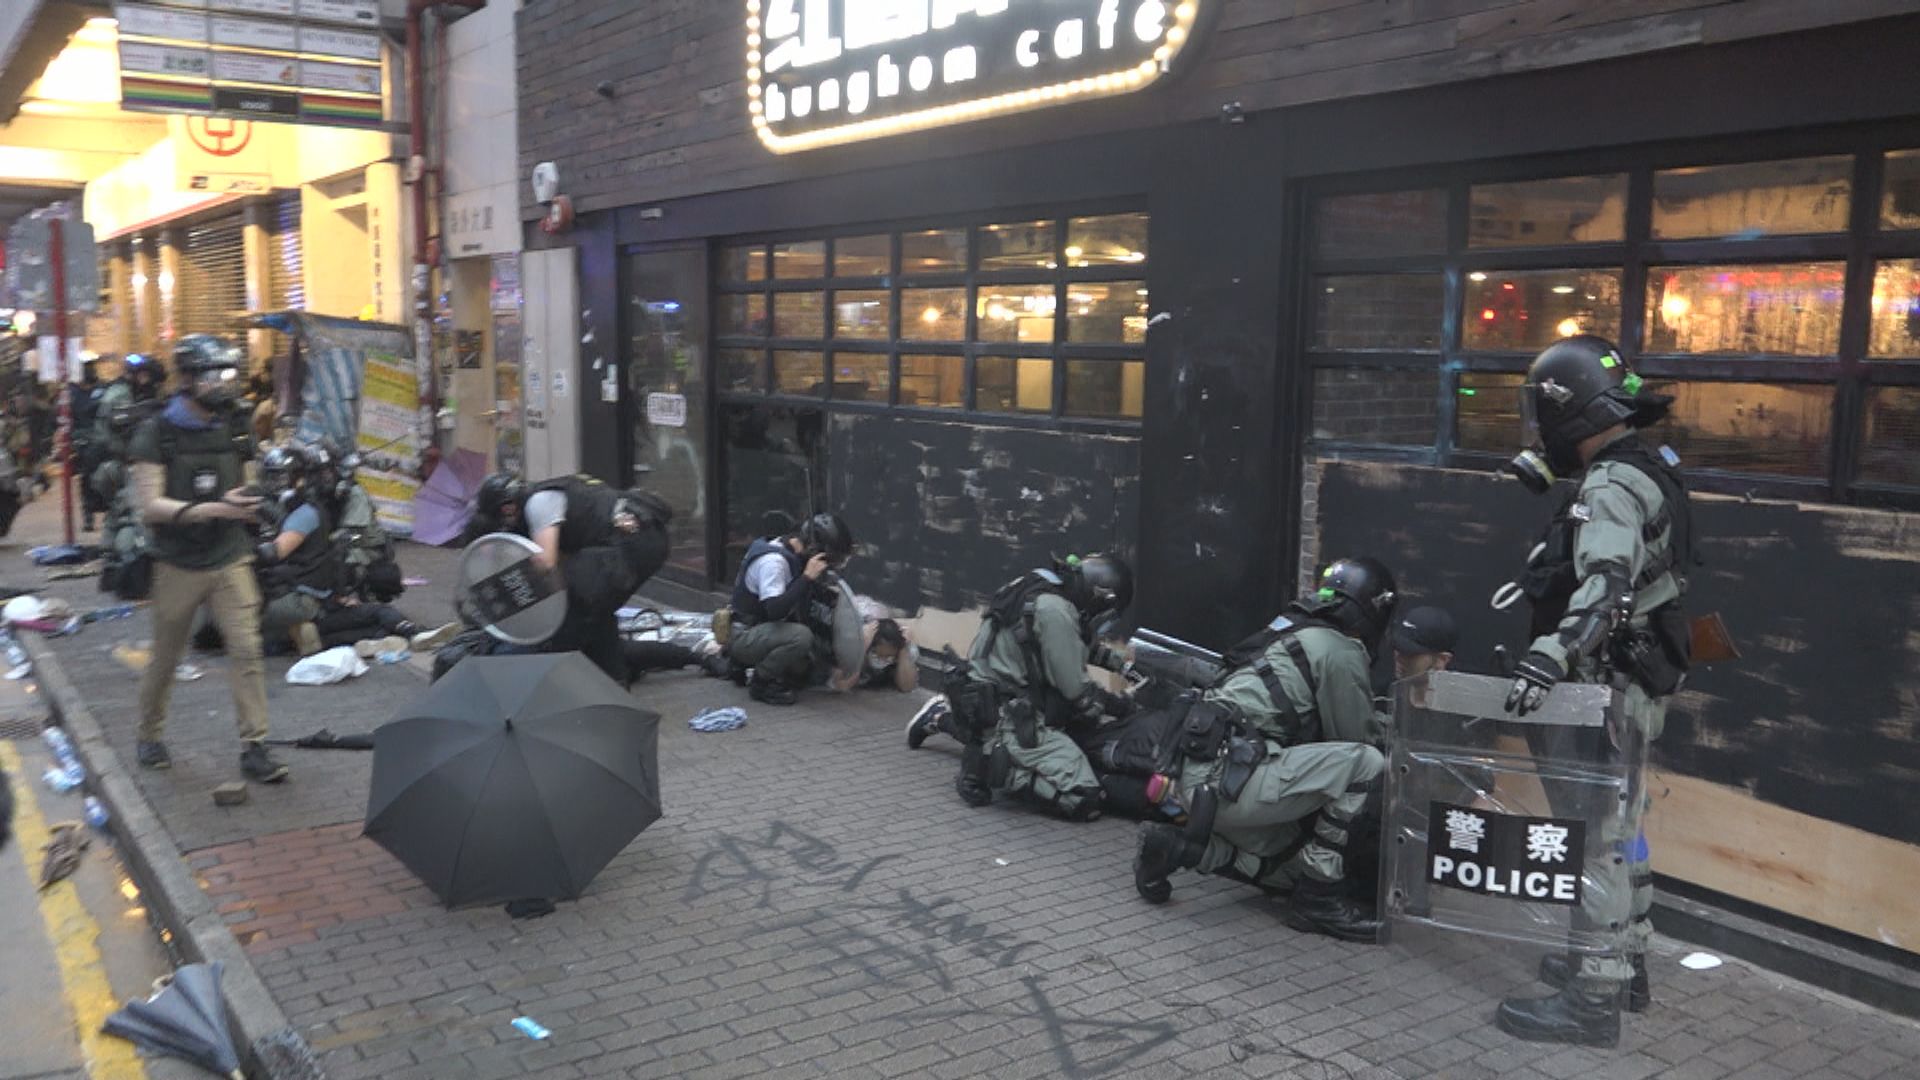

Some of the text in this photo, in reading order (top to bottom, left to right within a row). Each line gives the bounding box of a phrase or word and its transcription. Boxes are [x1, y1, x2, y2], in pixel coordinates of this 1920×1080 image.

[765, 45, 976, 122] hunghom
[1445, 809, 1568, 863] 警察
[1433, 854, 1576, 900] POLICE
